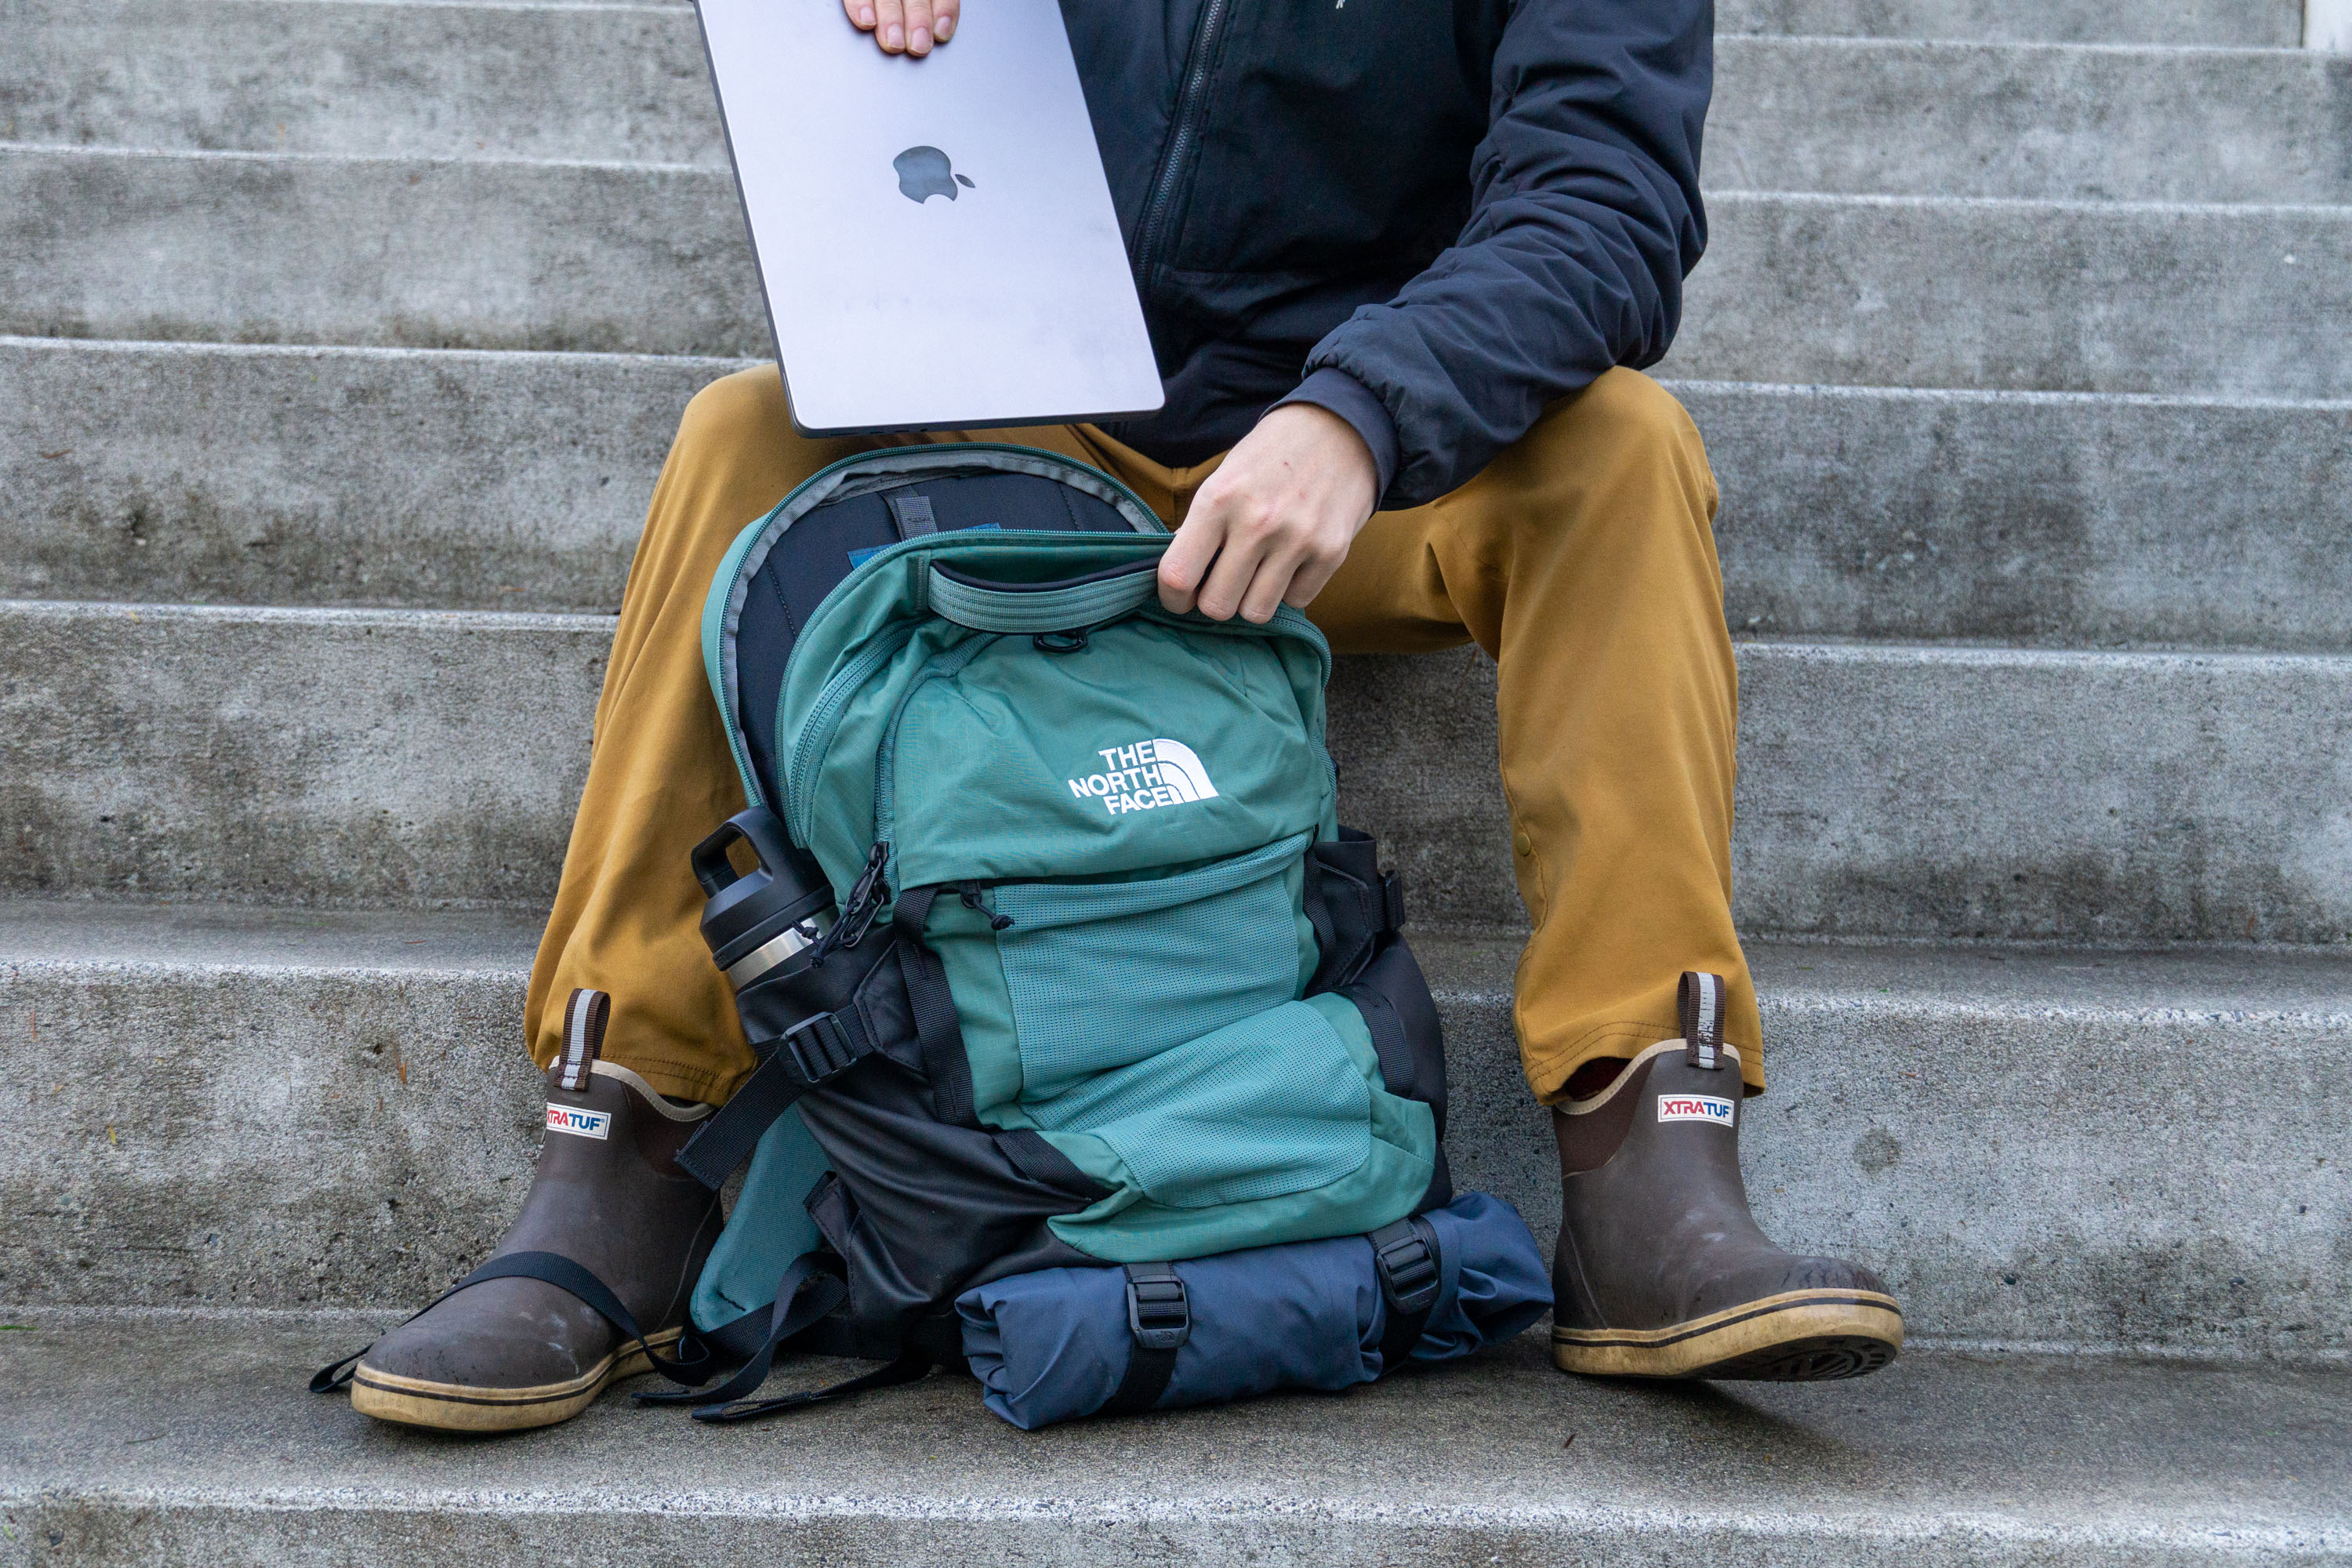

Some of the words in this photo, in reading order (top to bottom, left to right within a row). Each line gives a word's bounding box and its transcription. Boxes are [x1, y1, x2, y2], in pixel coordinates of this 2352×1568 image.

[1098, 740, 1157, 771] THE
[1068, 764, 1163, 798] NORTH
[1103, 786, 1174, 815] FACE
[1664, 1101, 1730, 1118] XTRATUF
